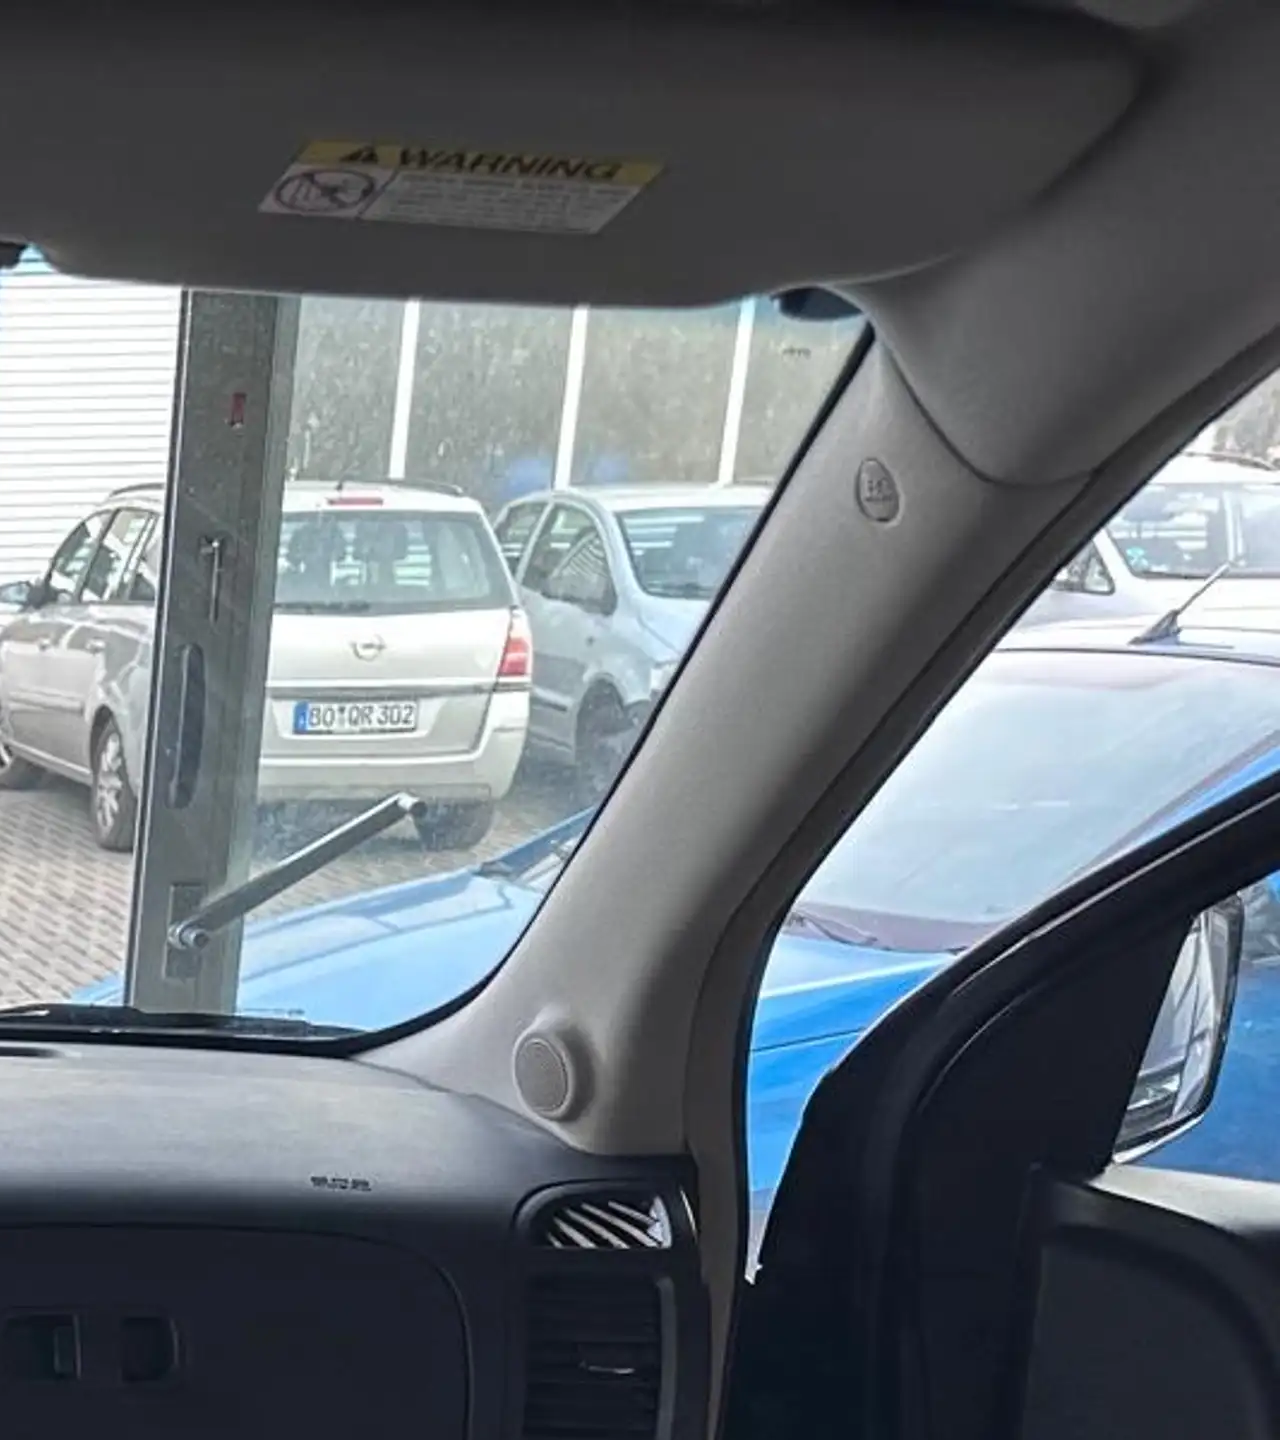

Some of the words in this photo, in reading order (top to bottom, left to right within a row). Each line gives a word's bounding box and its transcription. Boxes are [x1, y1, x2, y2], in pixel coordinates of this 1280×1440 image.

[398, 147, 622, 180] WARNING
[309, 706, 335, 727] BO
[348, 704, 373, 726] QR
[376, 703, 414, 725] 302
